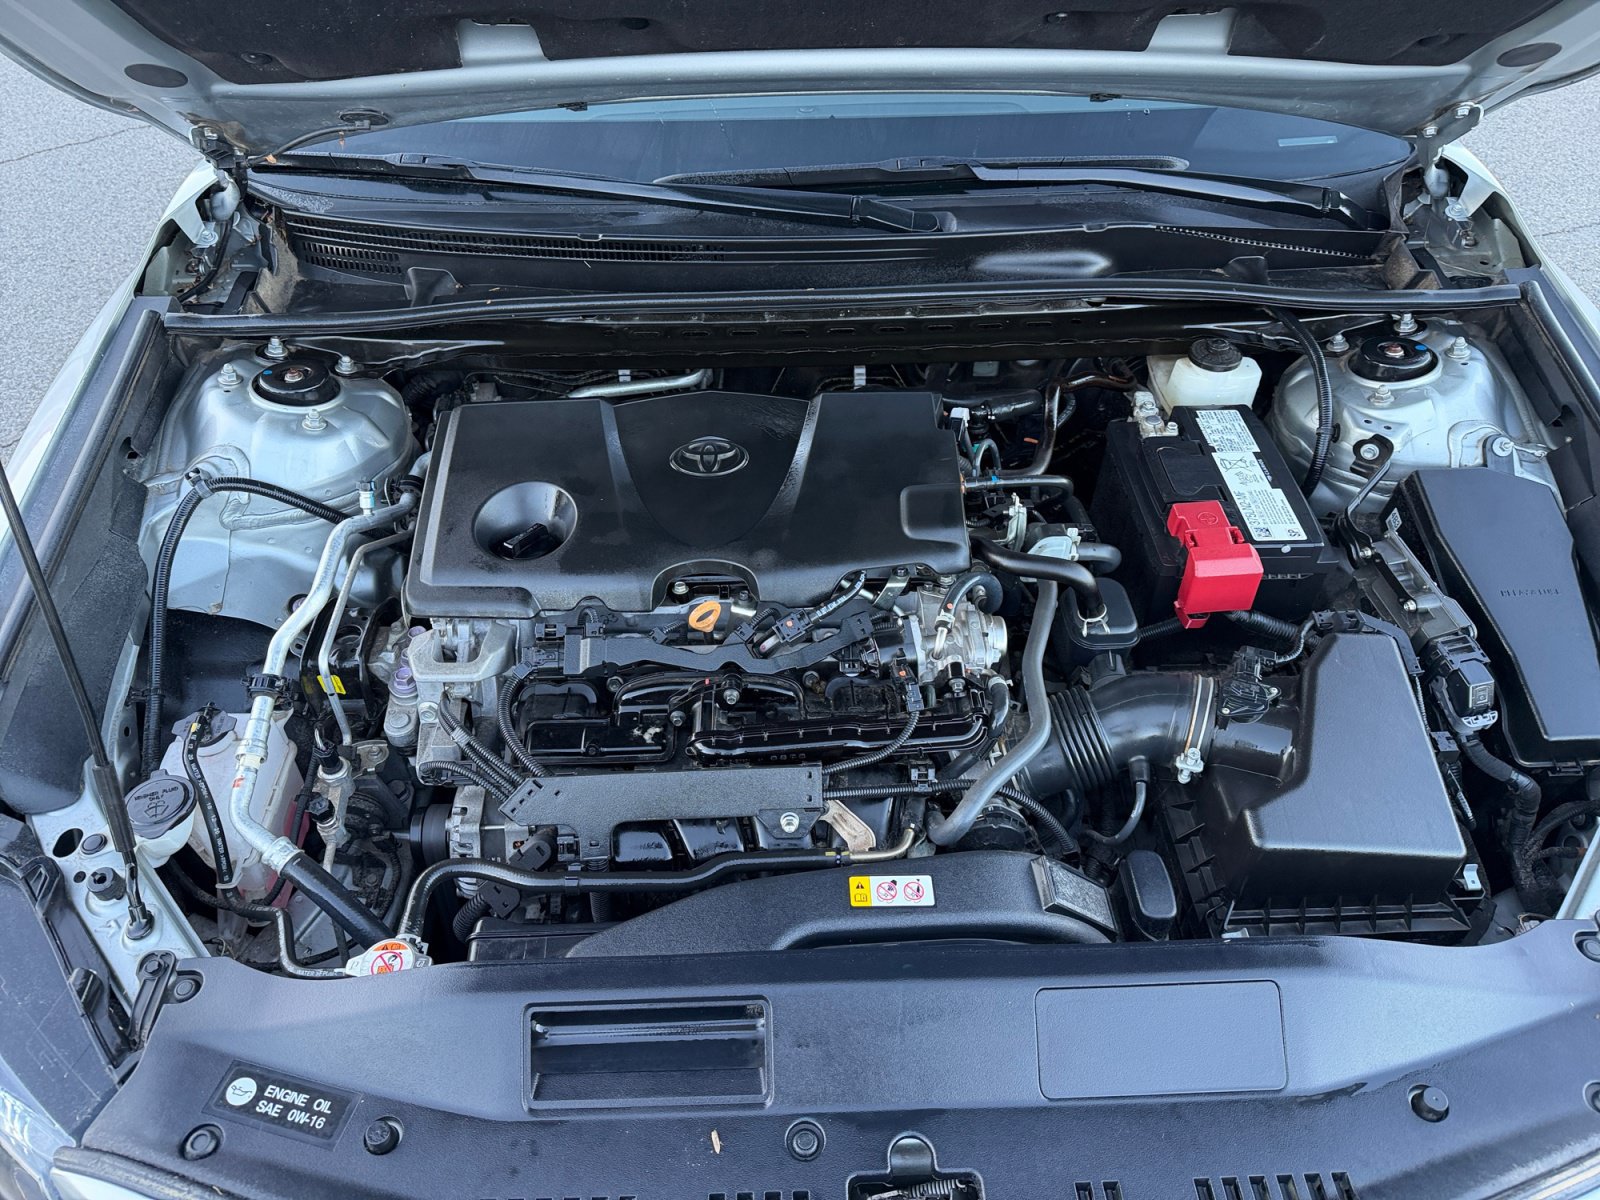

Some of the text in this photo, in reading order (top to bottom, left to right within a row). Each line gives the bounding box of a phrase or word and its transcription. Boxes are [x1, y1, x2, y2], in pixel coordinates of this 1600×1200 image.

[264, 1084, 332, 1114] ENGINE OIL
[255, 1100, 326, 1129] SAE 0W-16
